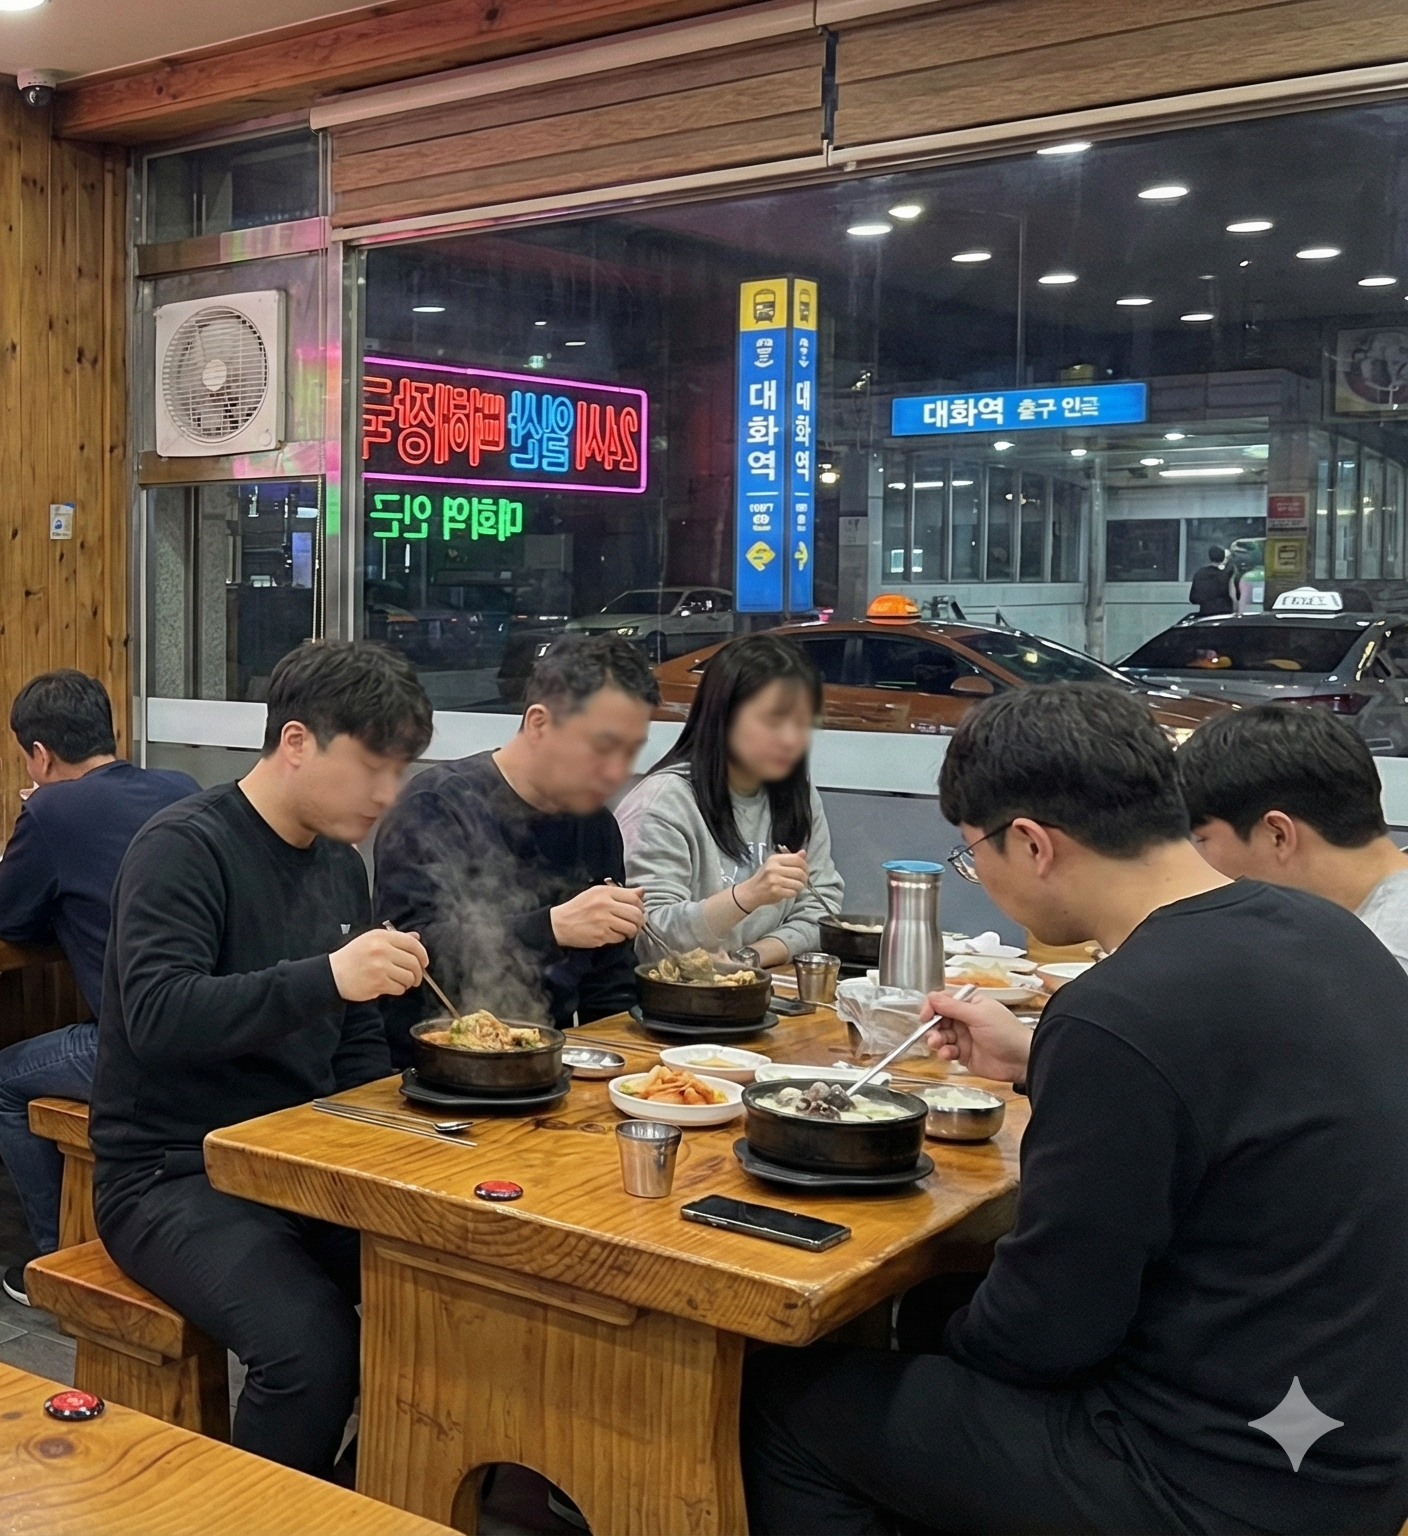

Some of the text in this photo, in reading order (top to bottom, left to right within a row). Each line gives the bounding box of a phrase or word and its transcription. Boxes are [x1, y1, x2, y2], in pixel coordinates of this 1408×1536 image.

[747, 379, 779, 481] 대화역
[795, 380, 812, 482] 대화역
[923, 396, 1004, 428] 대화역
[1017, 398, 1058, 421] 출구
